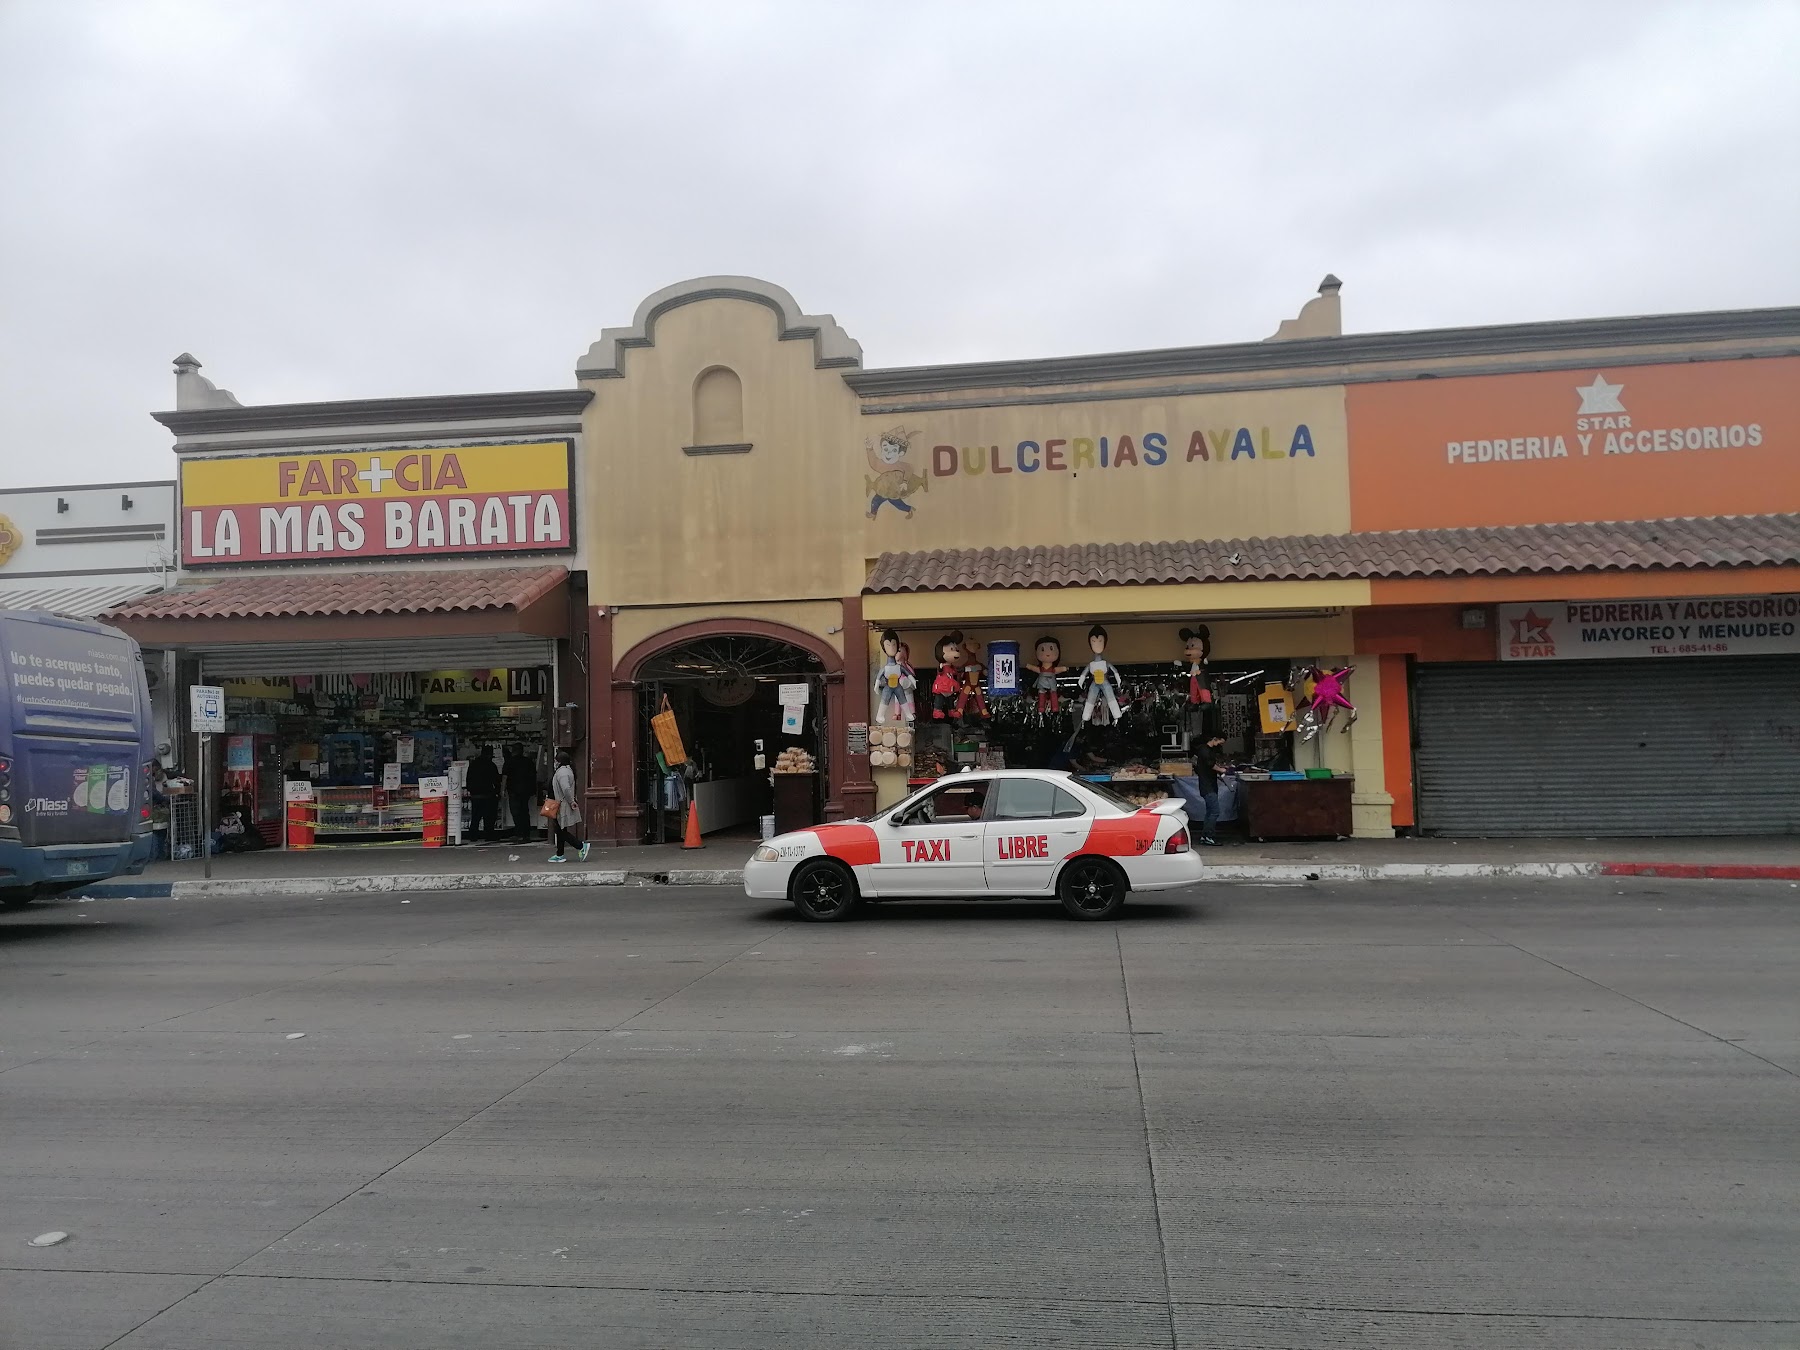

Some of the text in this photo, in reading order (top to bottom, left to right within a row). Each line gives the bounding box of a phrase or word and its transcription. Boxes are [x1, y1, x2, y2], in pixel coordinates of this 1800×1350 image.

[1576, 415, 1632, 431] STAR
[932, 424, 1315, 477] DULCERIAS AYALA
[1447, 423, 1763, 464] PEDRERIA Y ACCESORIOS
[190, 494, 562, 557] LA MAS BARATA
[1566, 598, 1800, 624] PEDRERIA Y ACCESORIO
[1581, 622, 1795, 643] MAYOREO Y MENUDEO
[1509, 644, 1556, 657] STAR
[1679, 643, 1728, 653] 685-41-86
[10, 650, 123, 679] No te acerques tanto,
[13, 672, 133, 697] puedes quedar pegado.
[511, 670, 531, 695] LA
[901, 839, 951, 862] TAXI
[998, 835, 1048, 860] LIBRE
